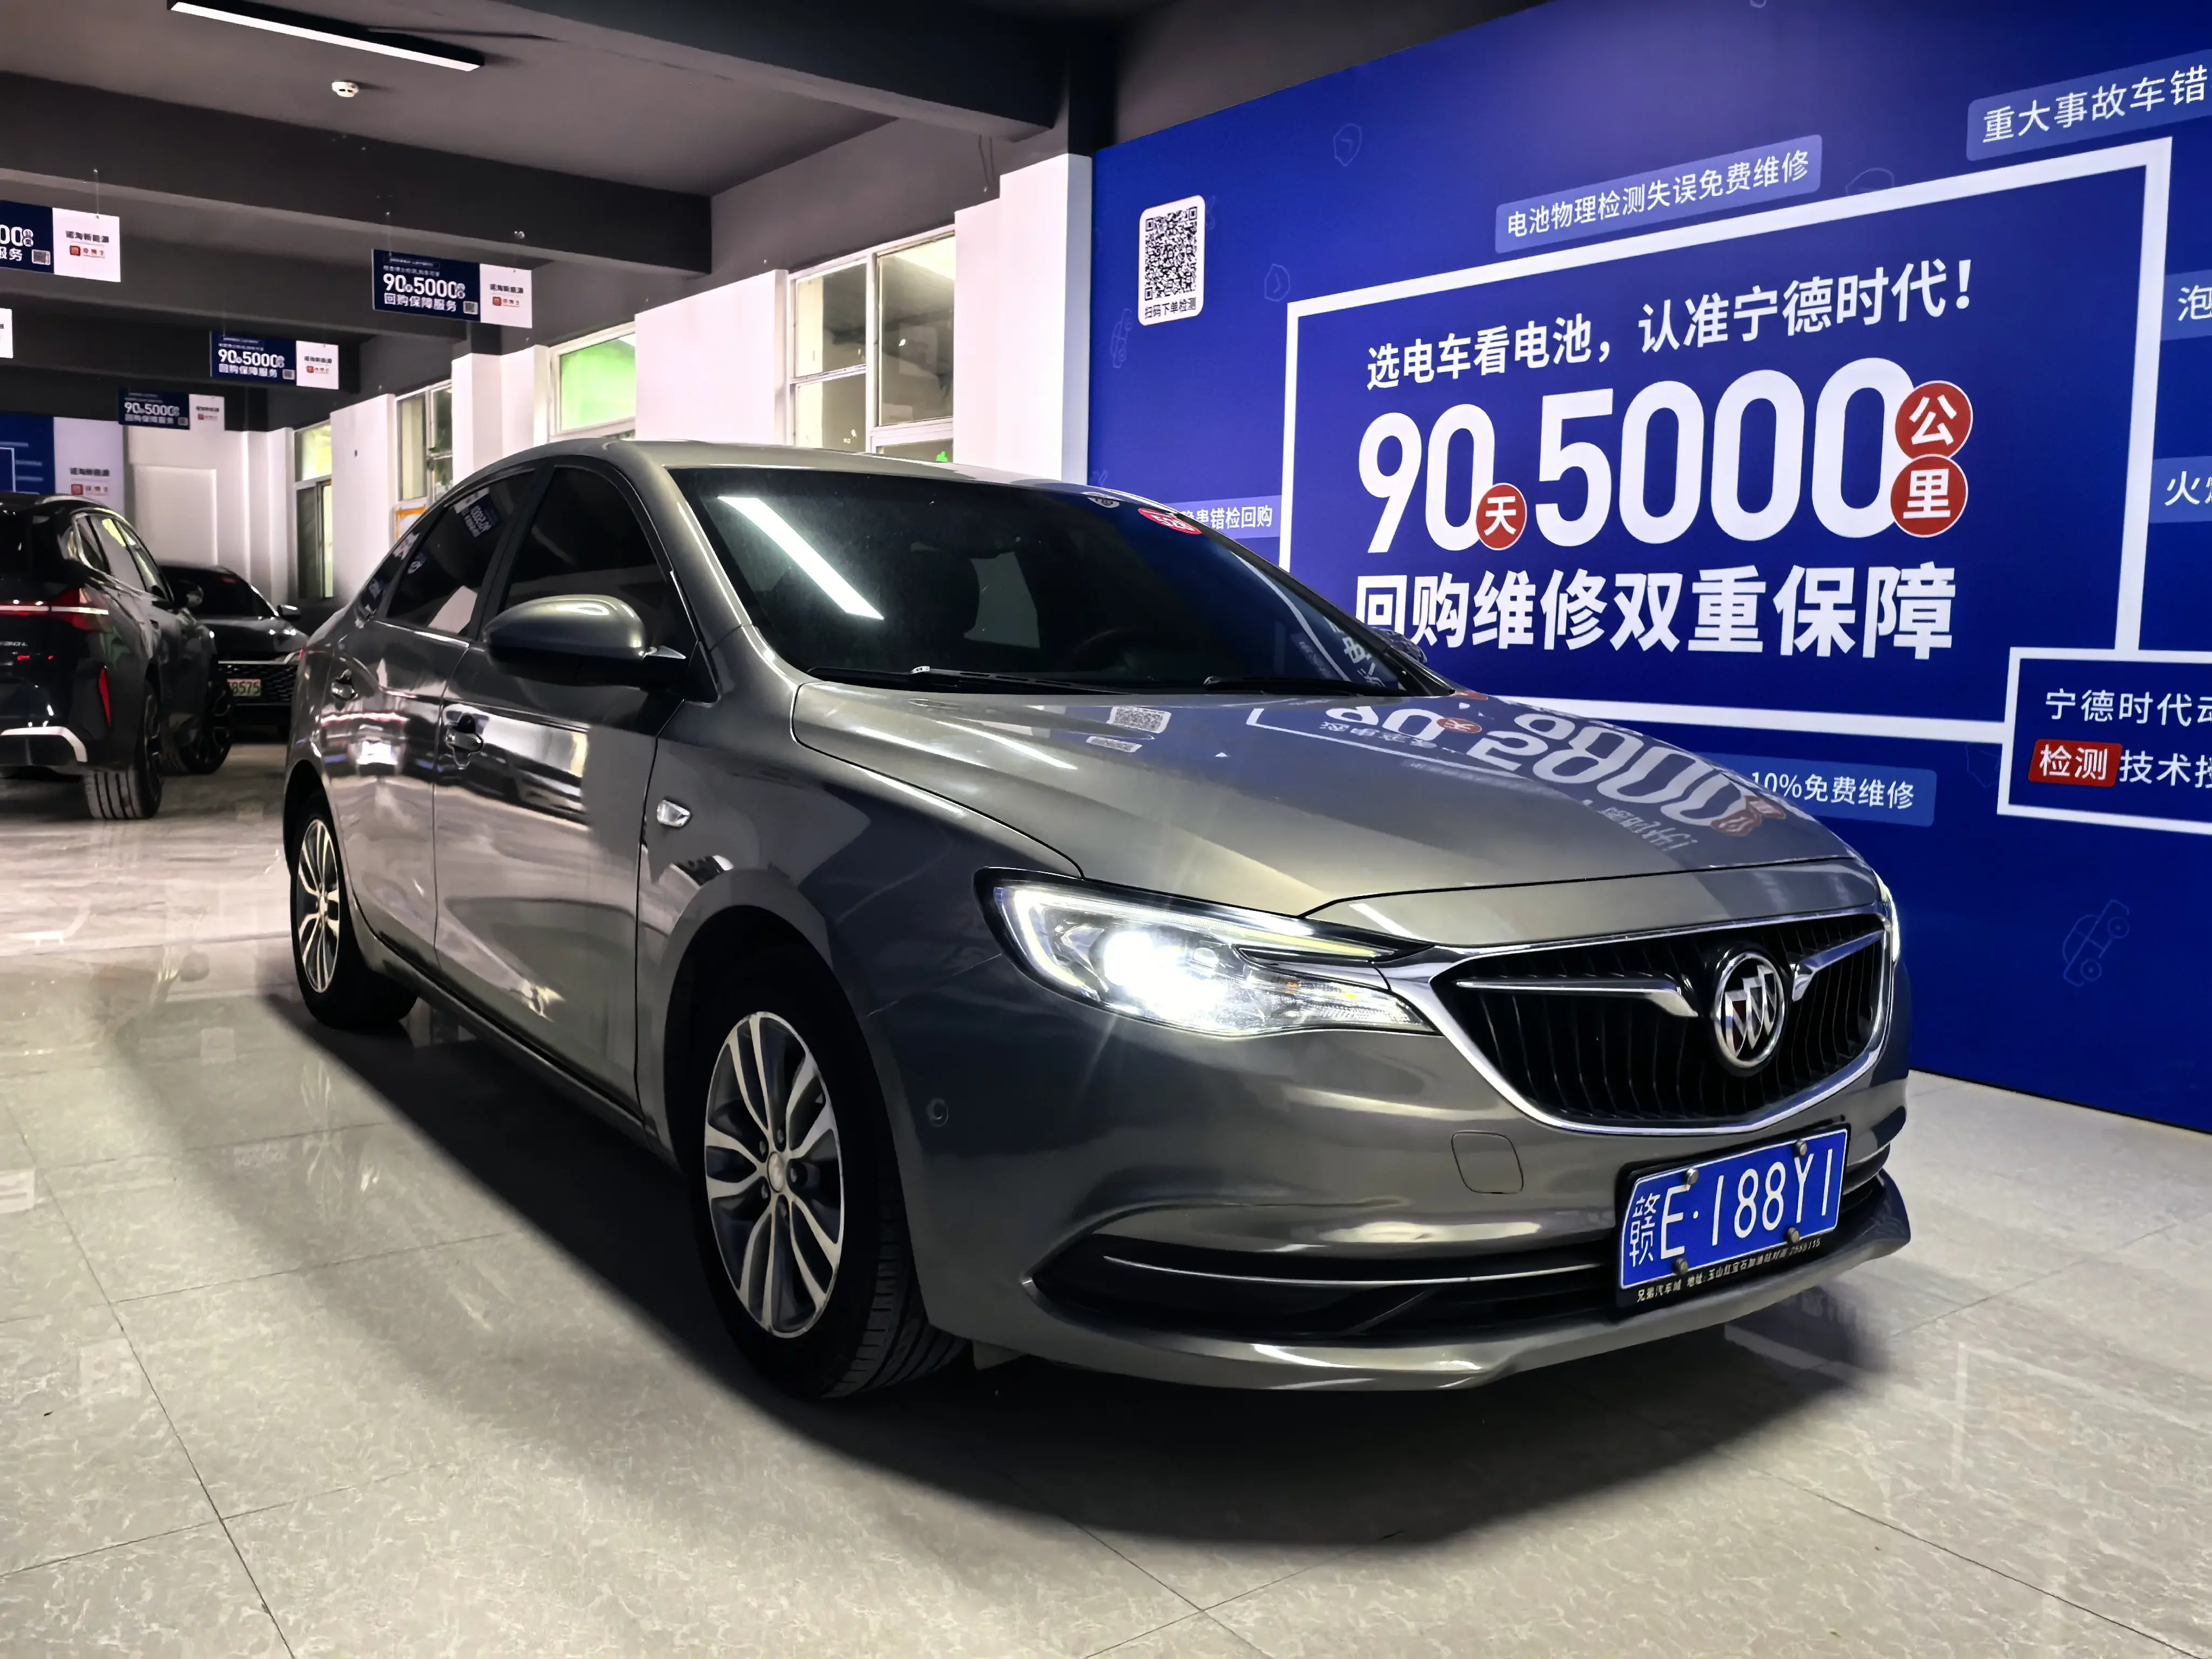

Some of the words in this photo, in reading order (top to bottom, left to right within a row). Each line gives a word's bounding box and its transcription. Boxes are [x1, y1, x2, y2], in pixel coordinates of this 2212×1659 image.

[1982, 64, 2208, 143] 重大事故车错
[1508, 149, 1809, 238] 电池物理检测失误免费维修
[2164, 470, 2212, 507] 火
[1355, 561, 1956, 660] 回购维修双重保障
[1751, 771, 1914, 810] 10%免费维修
[2039, 744, 2108, 780] 检测
